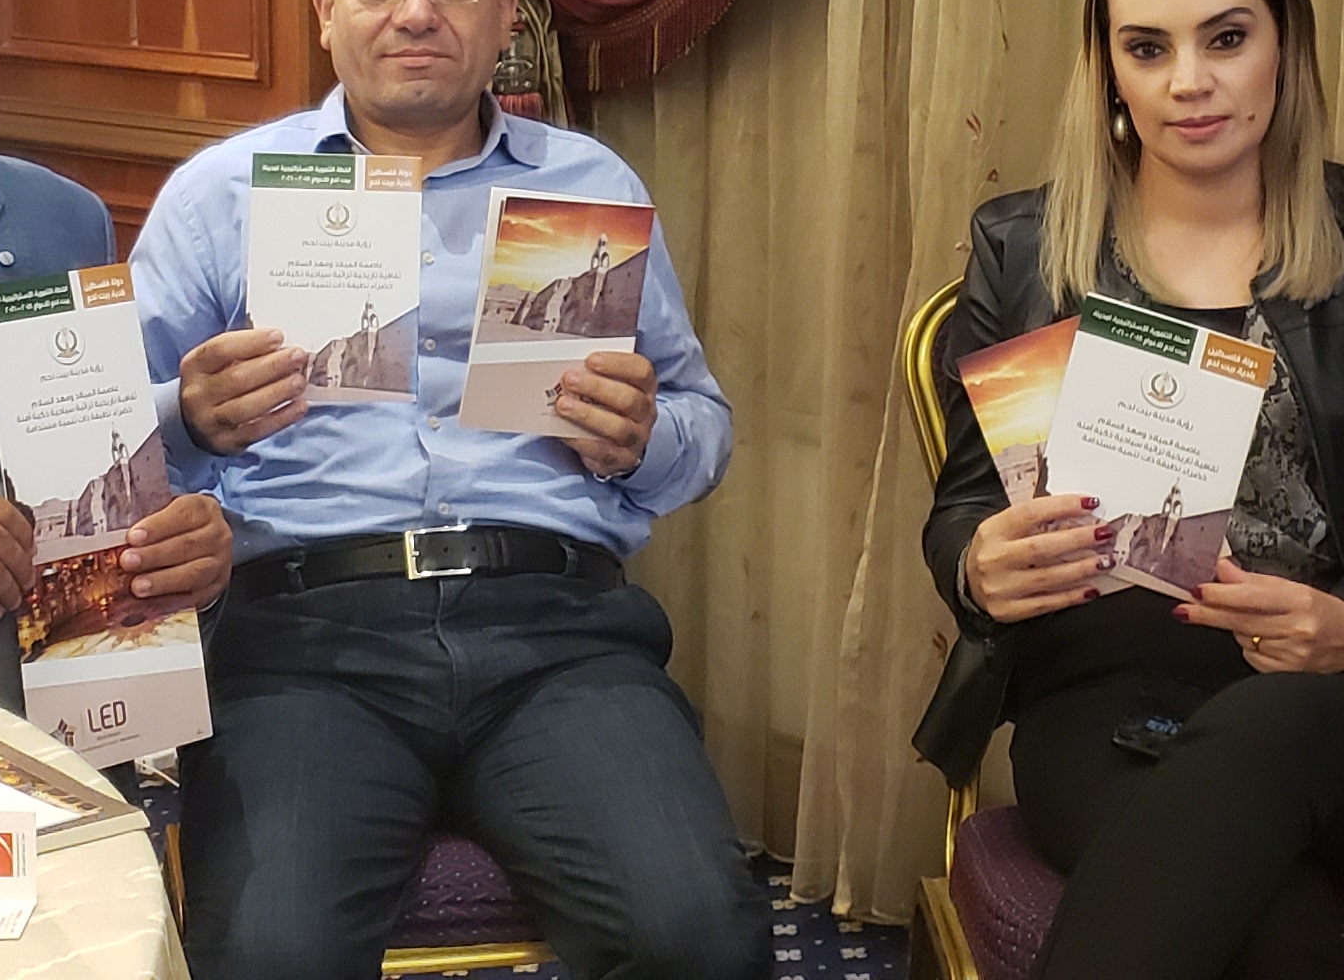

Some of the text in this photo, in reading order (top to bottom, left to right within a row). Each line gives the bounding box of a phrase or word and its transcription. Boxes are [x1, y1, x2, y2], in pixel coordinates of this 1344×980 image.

[368, 168, 397, 177] فلسطين
[369, 178, 381, 189] لحم
[382, 179, 396, 187] بيت
[302, 239, 318, 247] لحم
[334, 239, 355, 247] مدينة
[356, 240, 372, 249] رؤية
[287, 260, 312, 268] السلام
[286, 269, 304, 277] ذكية
[1207, 348, 1259, 369] دولة فلسطين
[1206, 358, 1256, 381] بلدية بيت لحم
[1117, 401, 1194, 431] رؤية مدينة بيت لحم
[1097, 417, 1125, 430] السلام
[1094, 426, 1113, 439] ذكية
[1148, 432, 1174, 446] الميلاد
[1114, 434, 1143, 448] سياحية
[1174, 441, 1201, 456] عاصمة
[1082, 434, 1207, 482] خضراء نظيفة ذات تنمية مستدامة
[1166, 450, 1193, 464] تاريخية
[86, 700, 128, 734] LED
